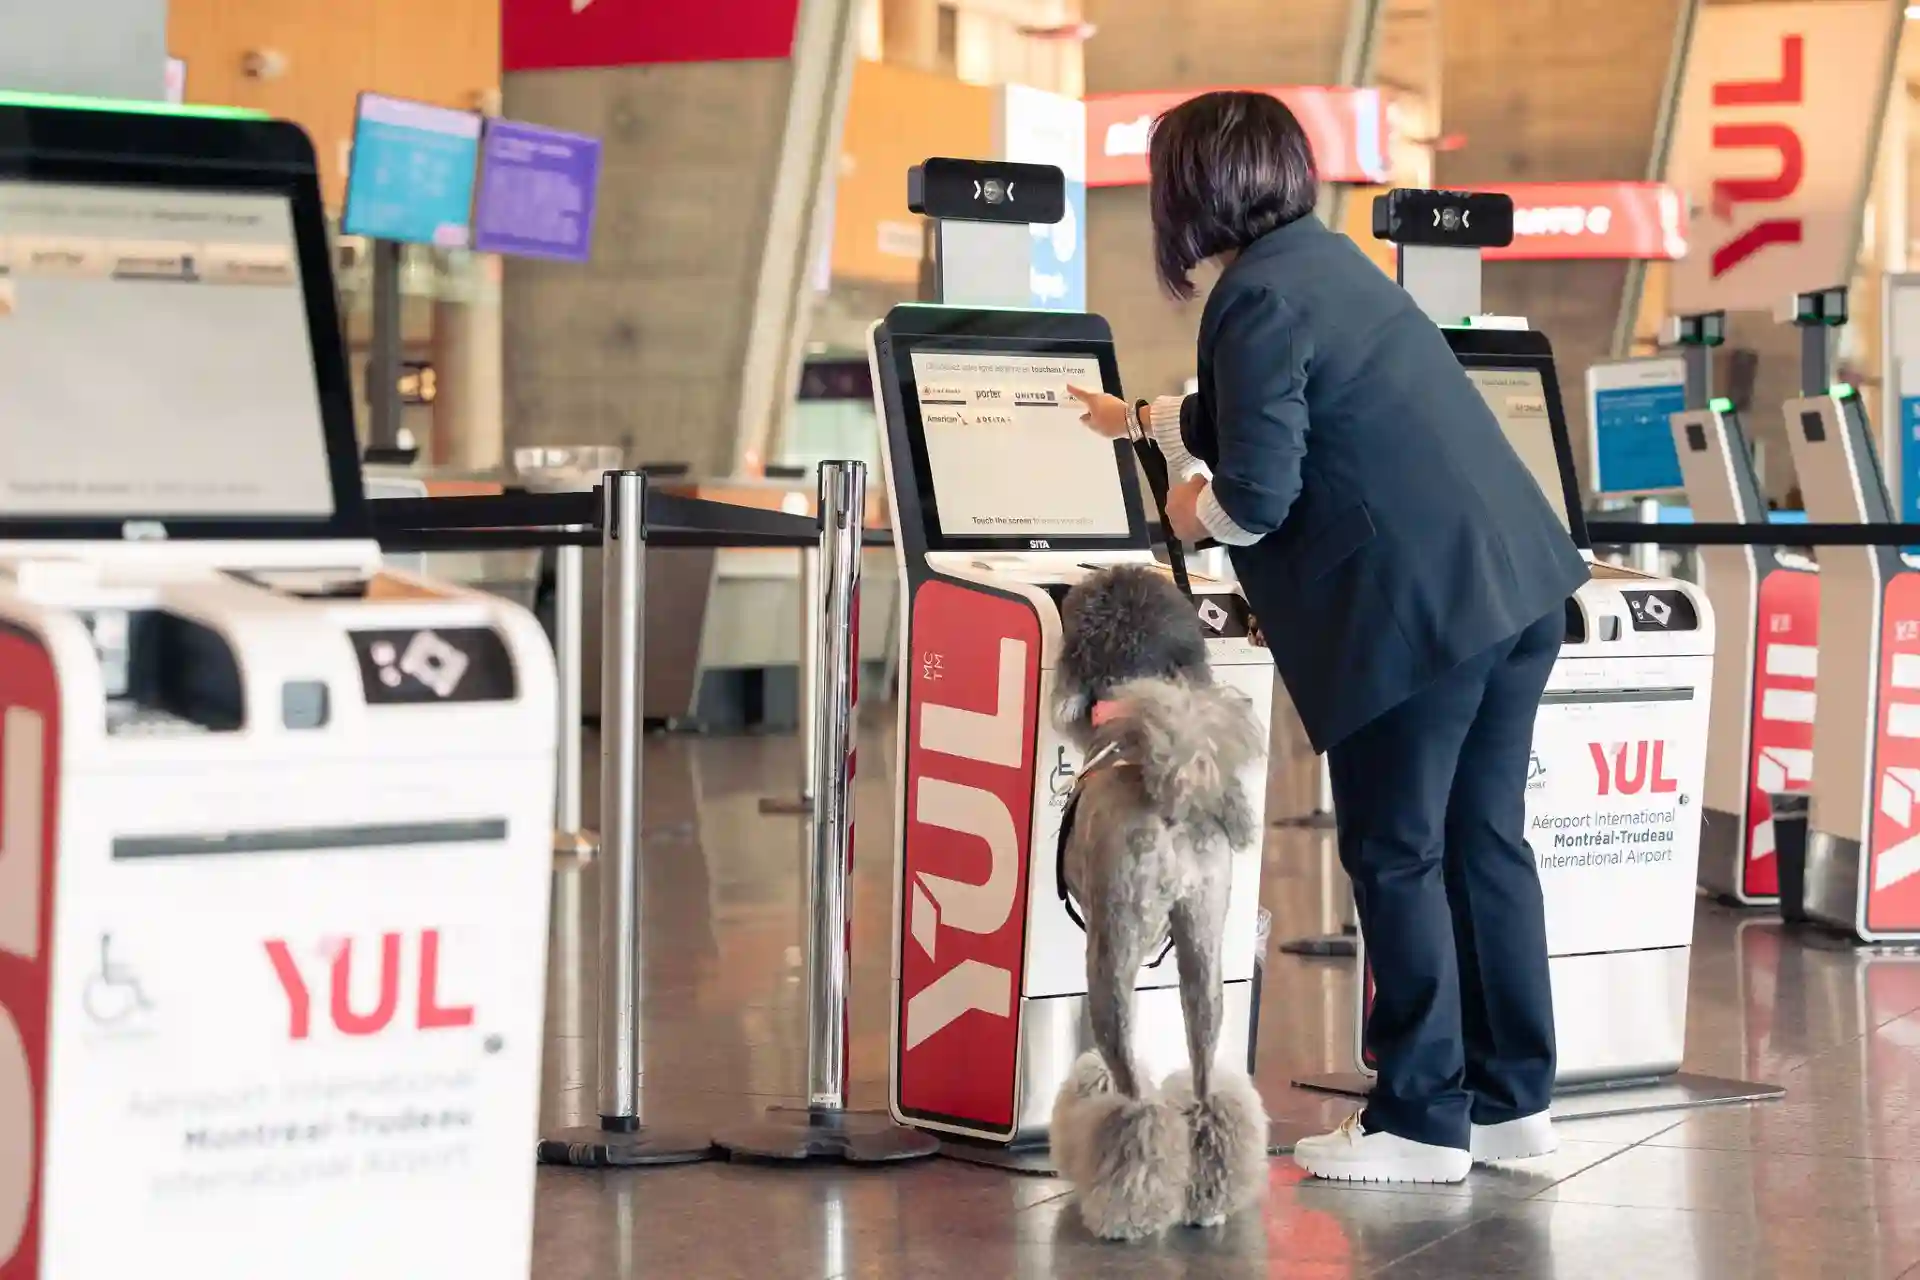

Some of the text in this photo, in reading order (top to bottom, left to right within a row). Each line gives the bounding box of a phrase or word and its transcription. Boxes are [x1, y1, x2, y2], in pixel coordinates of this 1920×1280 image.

[1712, 34, 1804, 279] YUL
[976, 389, 1001, 400] porter
[1015, 392, 1045, 400] UNITED
[927, 415, 958, 424] American
[982, 416, 1006, 424] DELTA
[972, 516, 994, 525] Touch
[995, 516, 1008, 525] the
[1008, 517, 1032, 525] screen
[1029, 540, 1050, 549] SITA
[1588, 740, 1677, 795] YUL
[1532, 808, 1676, 829] Aéroport International
[907, 637, 1027, 1051] YUL
[1554, 830, 1674, 848] Montréal-Trudeau
[1540, 848, 1672, 869] International Airport
[264, 929, 474, 1039] YUL
